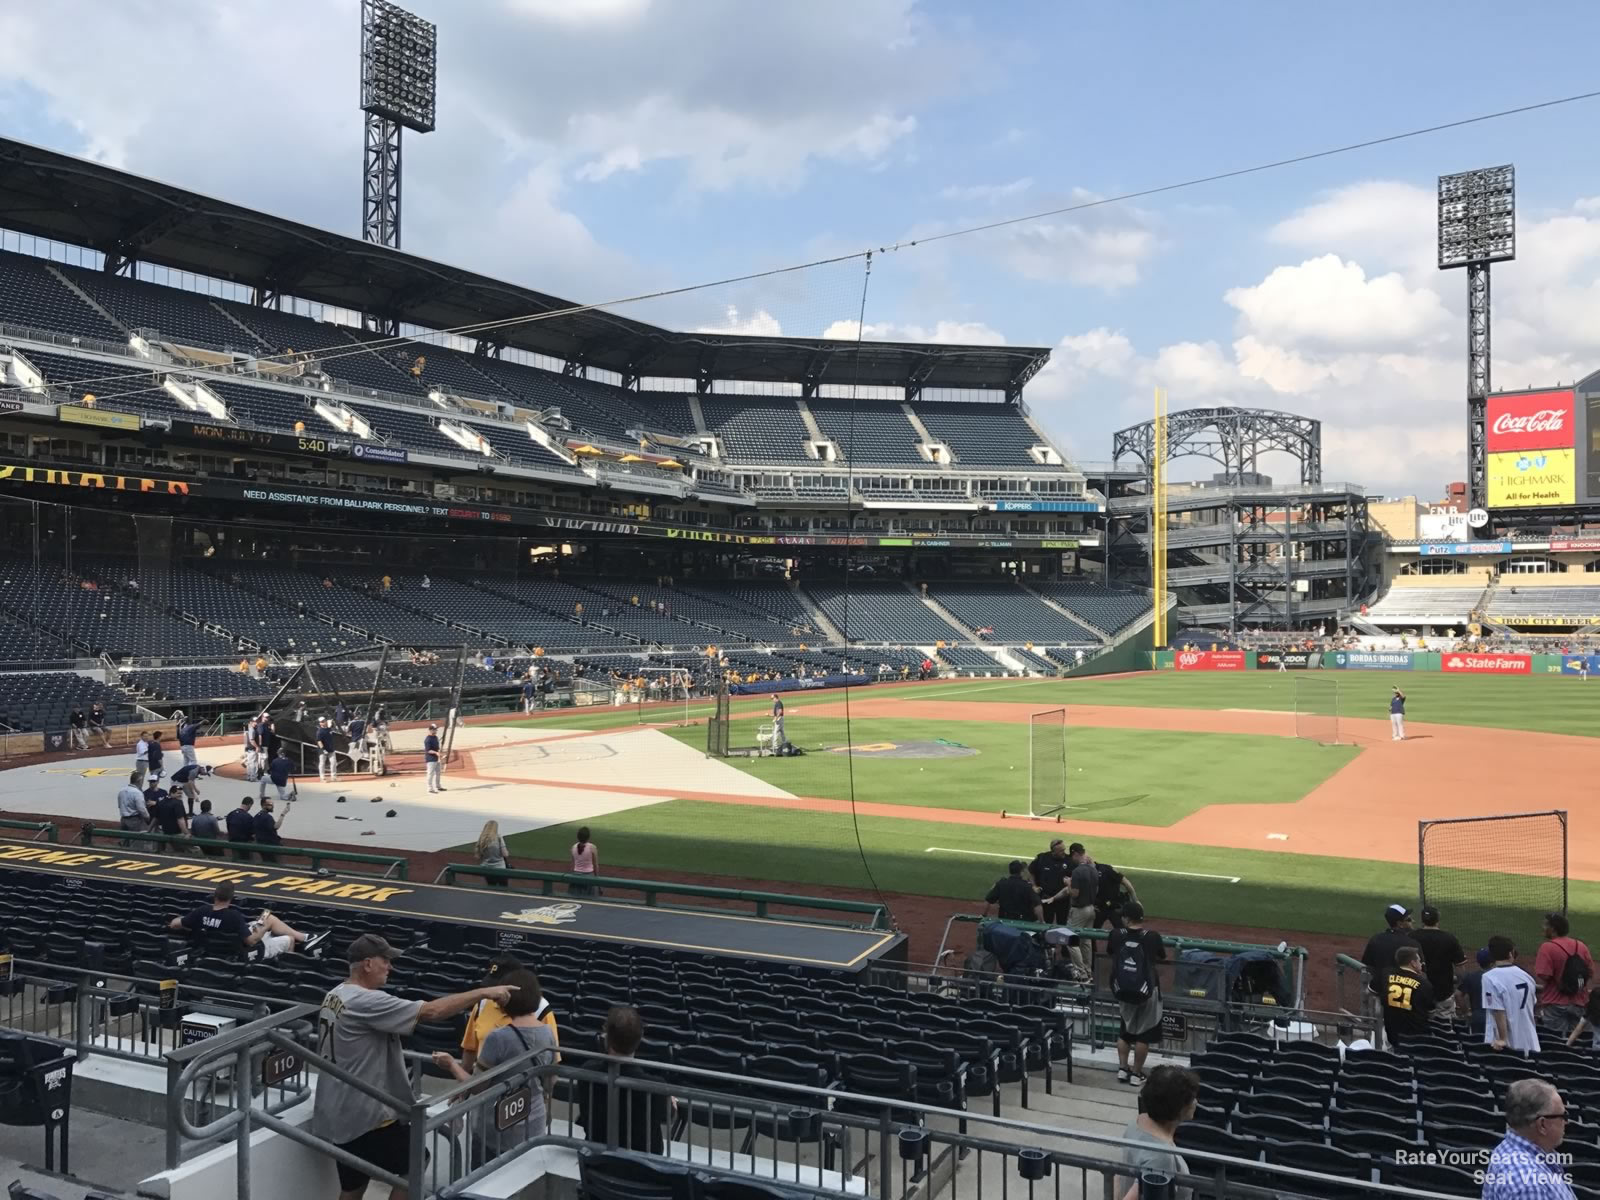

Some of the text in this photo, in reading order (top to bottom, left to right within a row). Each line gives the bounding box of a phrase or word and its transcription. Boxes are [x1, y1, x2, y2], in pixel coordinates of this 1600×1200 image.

[0, 402, 20, 410] ANER
[1493, 409, 1567, 434] Coca-Cola
[298, 438, 325, 452] 5:40
[365, 446, 405, 458] Consolidated
[1506, 491, 1560, 500] All for Health
[243, 489, 267, 500] NEED
[268, 492, 319, 504] ASSISTANCE
[320, 497, 343, 507] FROM
[344, 499, 382, 510] BALLPARK
[384, 503, 430, 514] PERSONNEL?
[433, 507, 449, 516] TEXT
[481, 512, 490, 520] TO
[1004, 502, 1032, 511] KOPPERS
[1469, 510, 1487, 523] Lite
[1502, 617, 1592, 625] IRON CITY BEER
[1350, 654, 1408, 664] BORDAS BORDAS
[99, 859, 161, 872] TO
[144, 864, 269, 884] PNC
[252, 875, 415, 902] PARK
[500, 932, 523, 940] CAUTION
[1389, 974, 1421, 990] CLEMENTE
[1388, 984, 1412, 1011] 21
[1515, 982, 1529, 1010] 7
[183, 1028, 214, 1038] CAUTION
[274, 1055, 294, 1075] 110
[503, 1096, 525, 1121] 109
